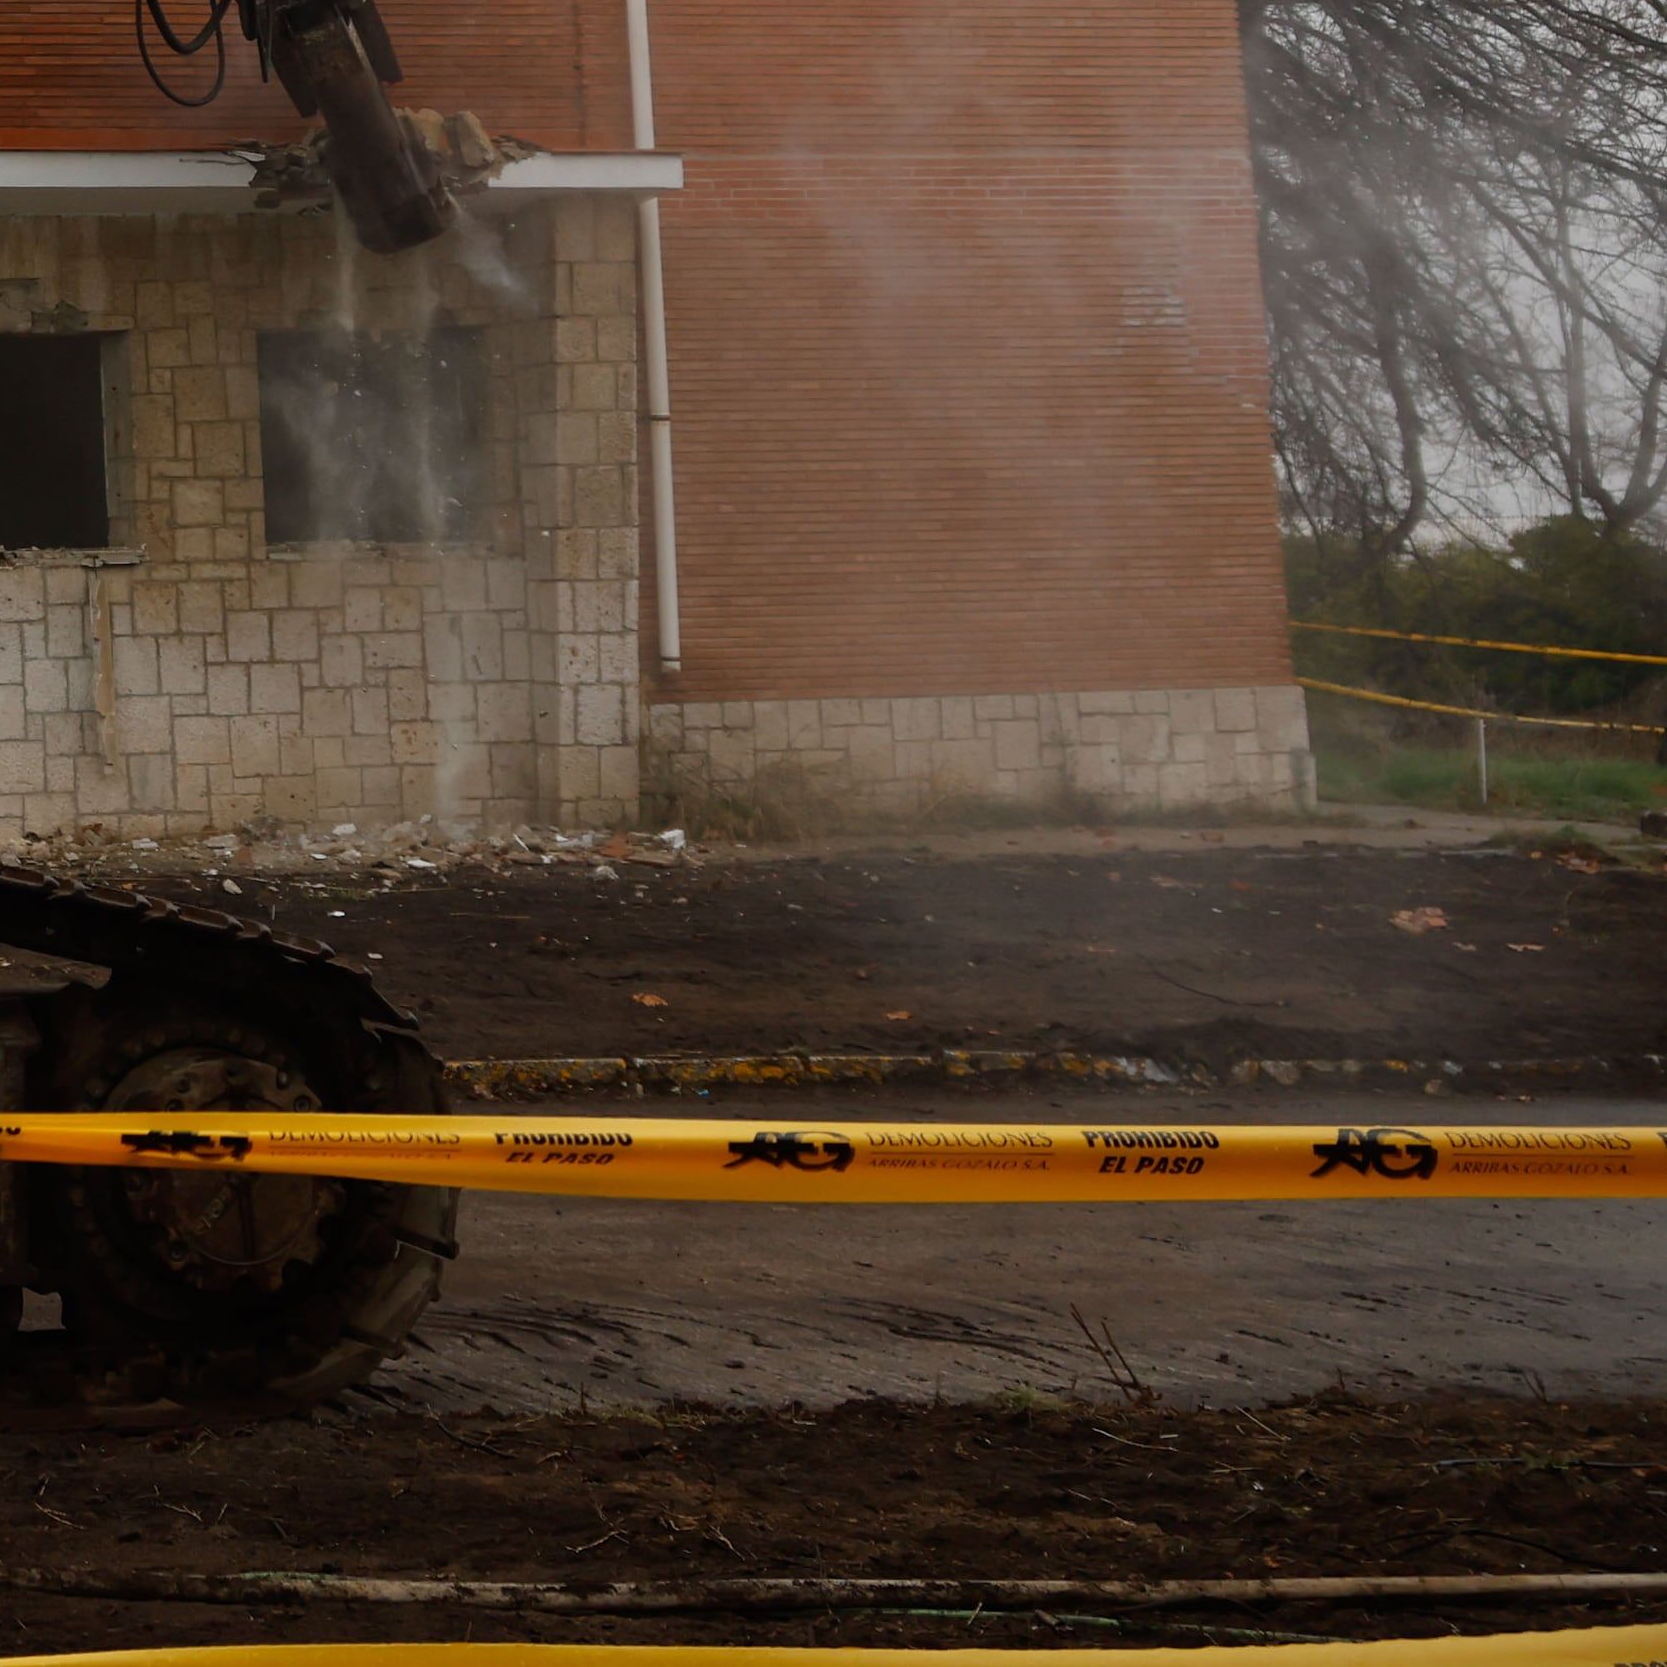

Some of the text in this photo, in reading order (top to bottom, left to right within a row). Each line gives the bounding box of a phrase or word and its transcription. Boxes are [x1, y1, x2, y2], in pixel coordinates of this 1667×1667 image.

[865, 1132, 1054, 1149] DEMOLICIONES
[1080, 1129, 1221, 1150] PROHIBIDO
[1444, 1132, 1632, 1151] DEMOLICIONES
[505, 1152, 616, 1165] EL PASO
[1099, 1156, 1206, 1175] EL PASO
